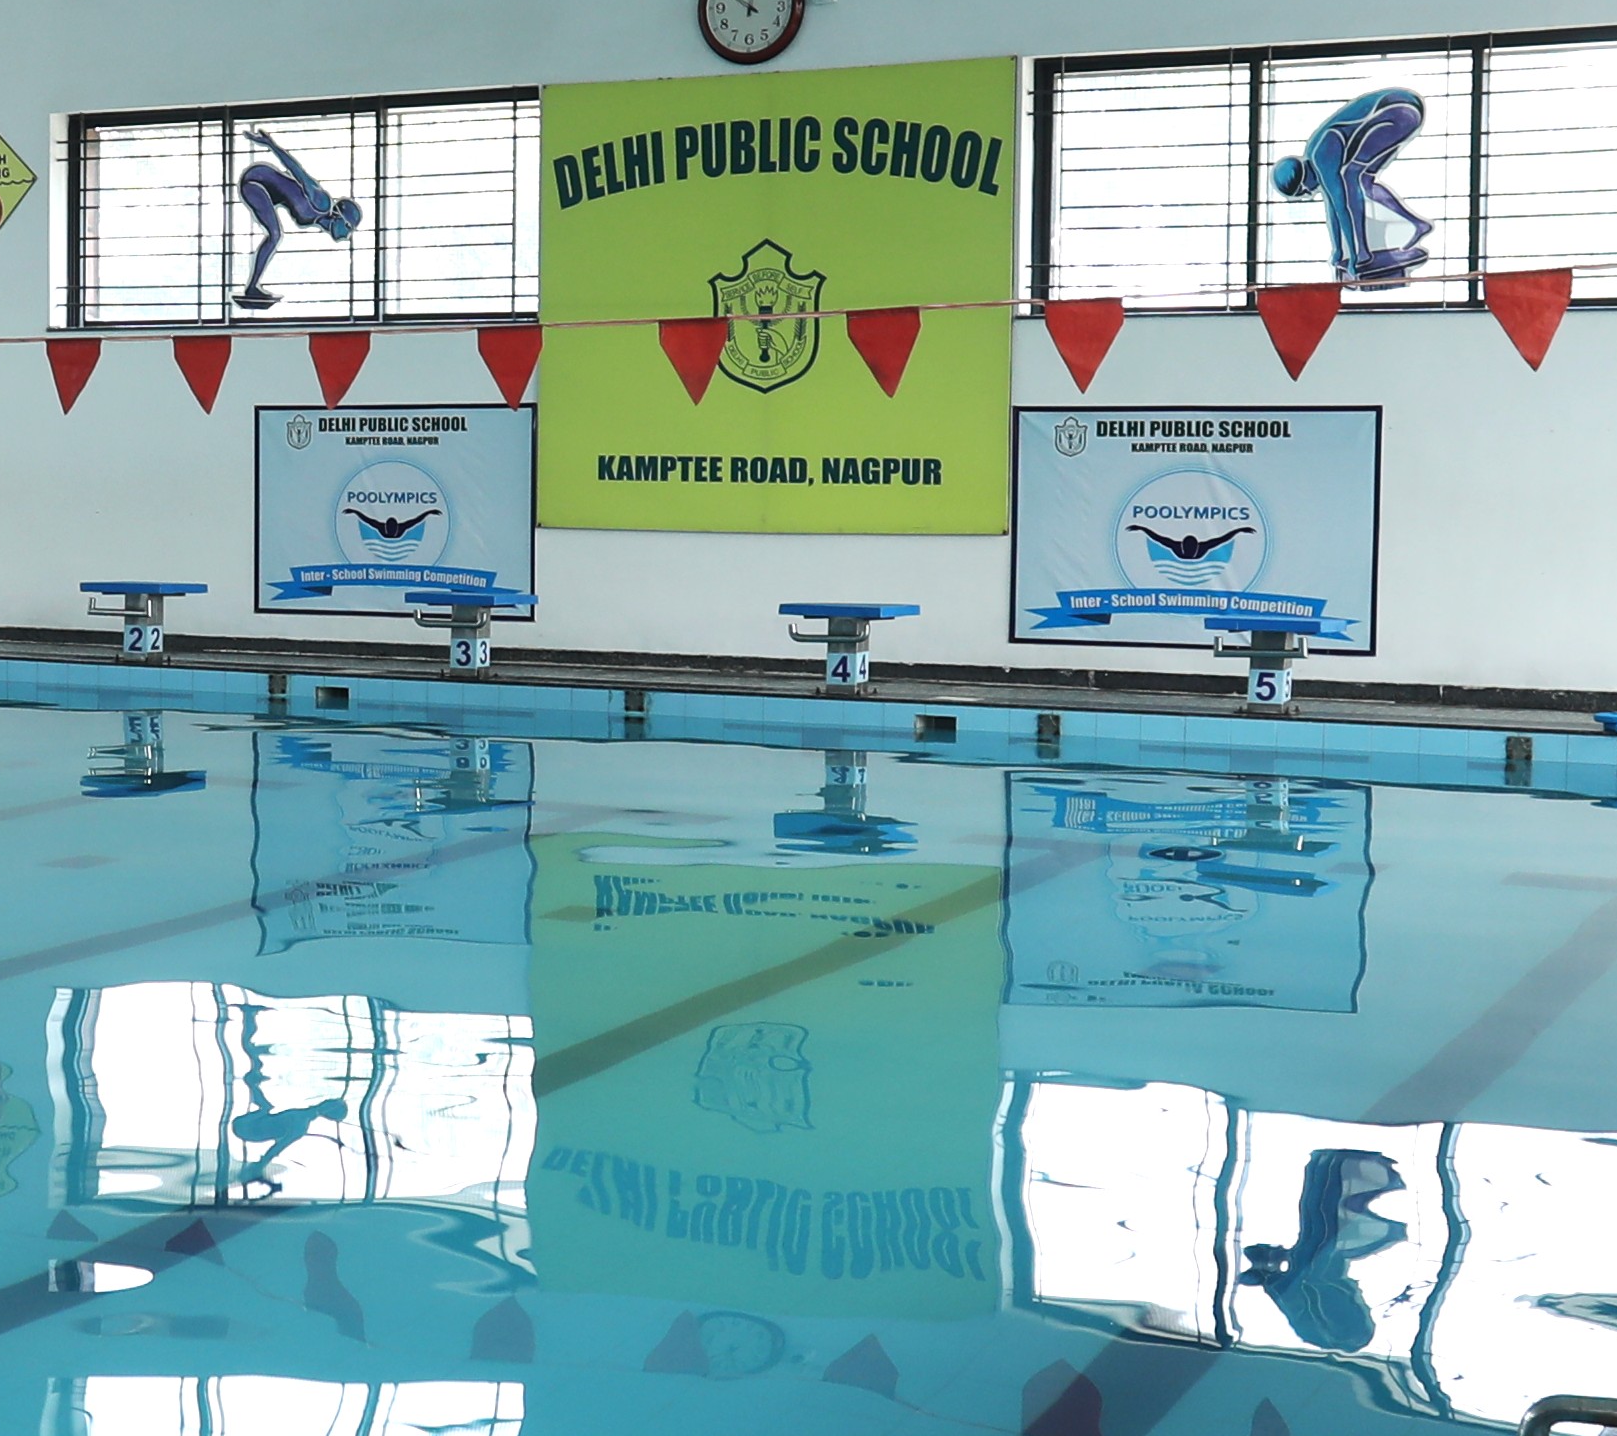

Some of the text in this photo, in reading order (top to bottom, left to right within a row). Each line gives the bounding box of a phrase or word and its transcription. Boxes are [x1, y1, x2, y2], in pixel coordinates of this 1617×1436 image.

[716, 3, 726, 14] 9
[777, 1, 786, 12] 3
[720, 19, 729, 29] 8
[773, 16, 781, 27] 4
[731, 30, 738, 41] 7
[744, 34, 754, 45] 6
[760, 29, 769, 41] 5
[553, 116, 1003, 210] DELHI PUBLIC SCHOOL
[786, 283, 803, 296] SELF
[750, 368, 780, 376] PUBLIC
[783, 341, 802, 366] SCHOOL
[318, 416, 467, 432] DELHI PUBLIC SCHOOL
[1096, 421, 1291, 437] DELHI PUBLIC SCHOOL
[345, 436, 381, 446] KAMPTEE
[407, 436, 439, 446] NAGPUR
[1131, 443, 1177, 453] KAMPTEE
[1211, 443, 1253, 453] NAGPUR
[598, 455, 942, 487] KAMPTEE ROAD, NAGPUR
[347, 490, 438, 504] POOLYMPICS
[1133, 505, 1250, 520] POOLYMPICS
[301, 570, 325, 582] Inter
[332, 568, 366, 581] School
[368, 569, 421, 583] Swimming
[423, 570, 487, 589] Competition
[1070, 595, 1102, 609] Inter
[1111, 593, 1156, 608] School
[1158, 594, 1228, 610] Swimming
[1231, 595, 1313, 617] Competition
[128, 627, 143, 652] 2
[150, 627, 160, 650] 2
[455, 641, 472, 667] 3
[479, 641, 488, 665] 3
[832, 655, 851, 683] 4
[858, 654, 867, 680] 4
[1255, 672, 1276, 702] 5
[1284, 672, 1292, 699] 5
